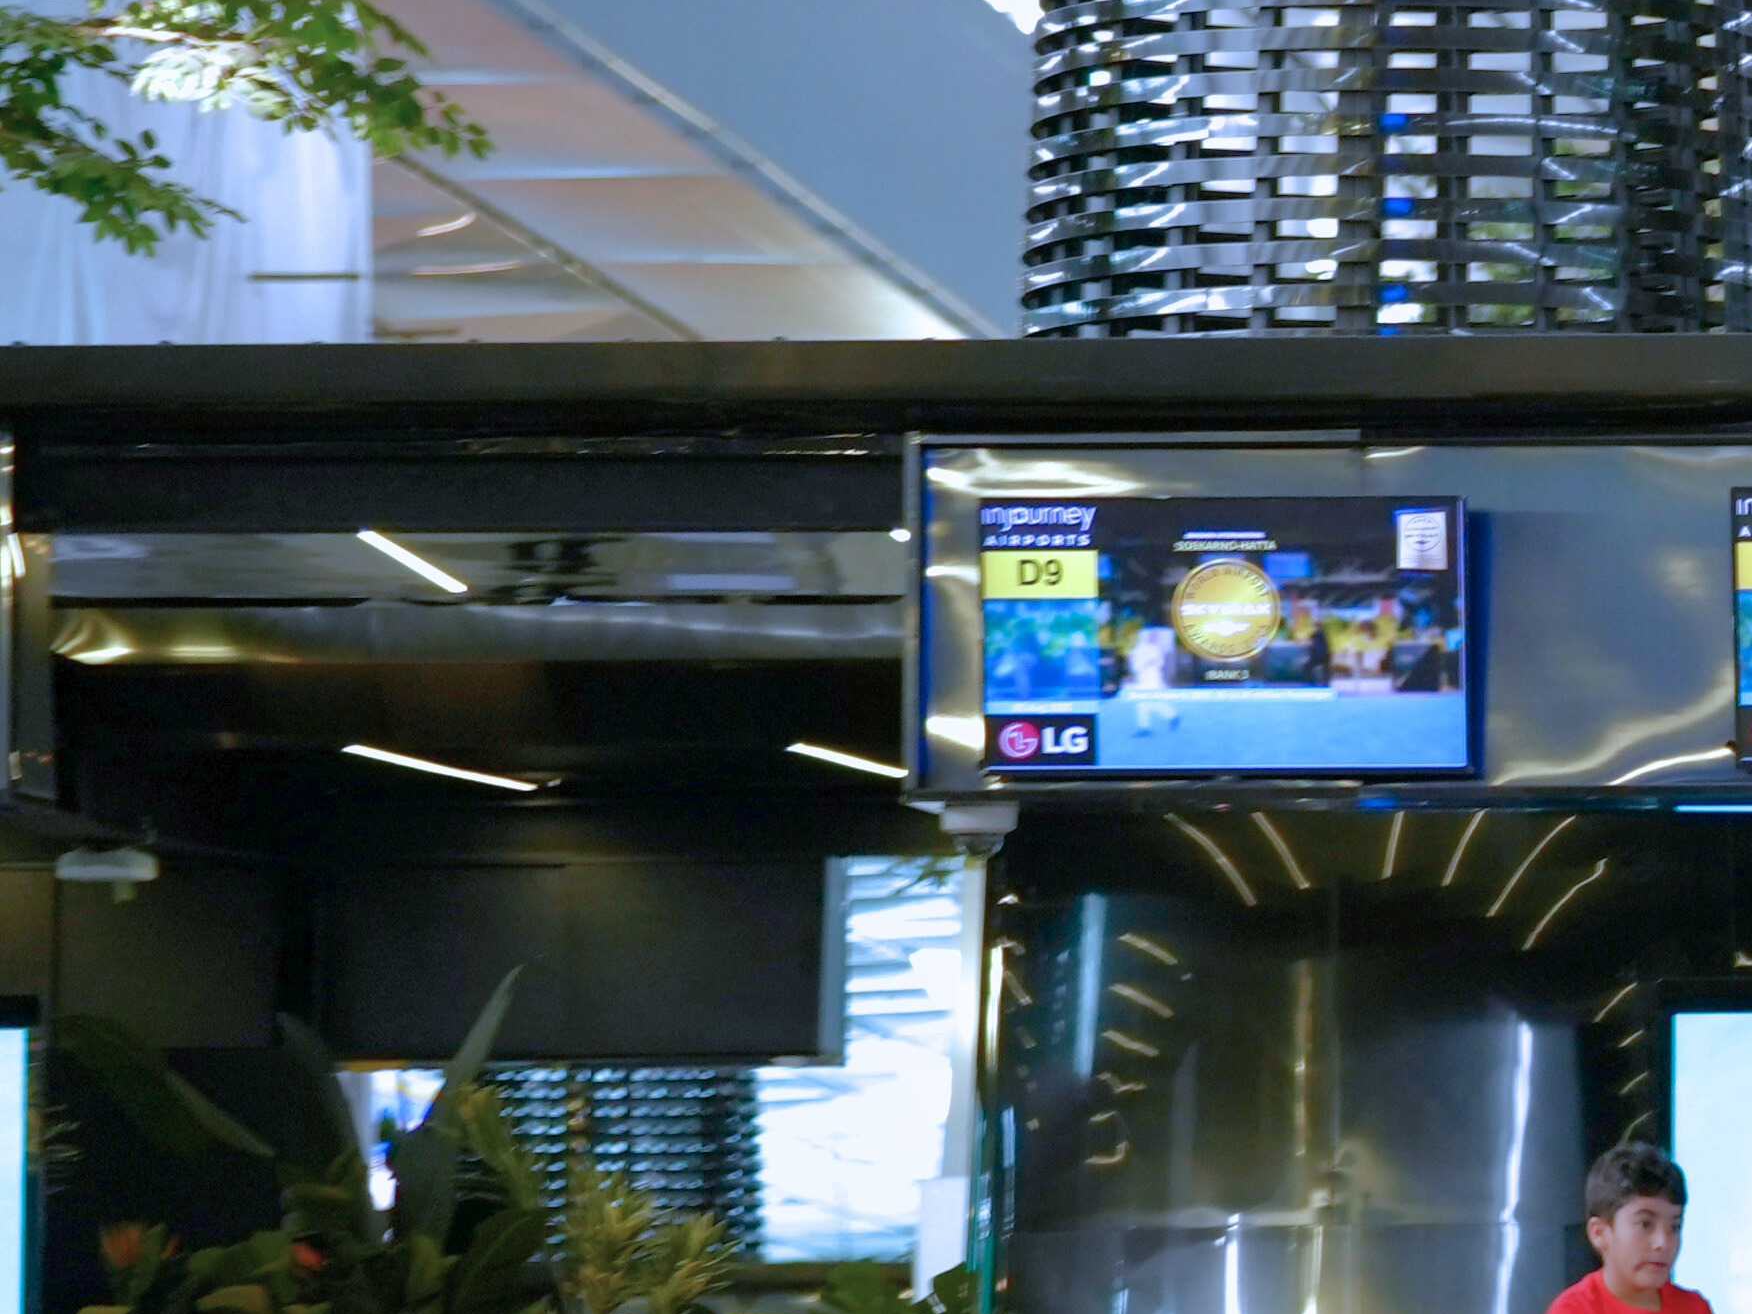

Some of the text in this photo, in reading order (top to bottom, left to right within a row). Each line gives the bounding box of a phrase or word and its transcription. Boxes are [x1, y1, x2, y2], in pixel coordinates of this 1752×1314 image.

[981, 506, 1097, 532] injourney
[983, 534, 1091, 547] AIRPORTS
[1016, 559, 1064, 586] D9
[1041, 726, 1089, 754] LG
